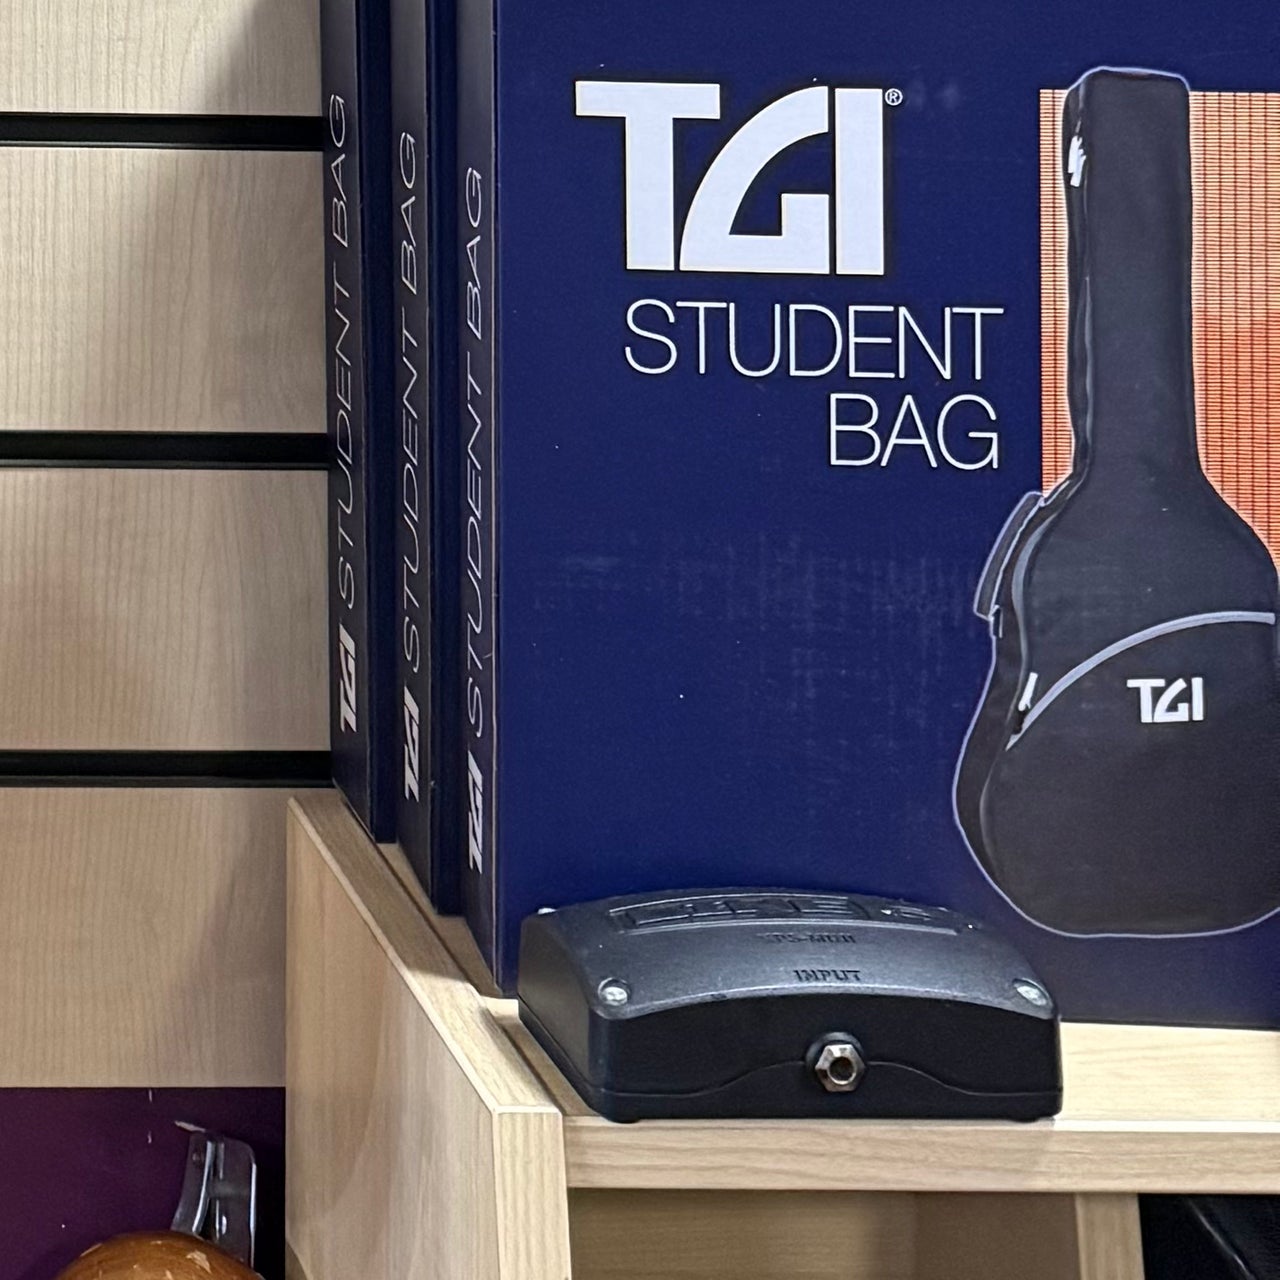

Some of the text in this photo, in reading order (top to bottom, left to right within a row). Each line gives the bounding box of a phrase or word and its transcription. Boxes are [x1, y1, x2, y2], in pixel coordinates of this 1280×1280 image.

[575, 80, 884, 276] TGI
[625, 298, 1005, 381] STUDENT
[329, 94, 357, 733] TGI STUDENT BAG
[399, 132, 421, 803] TGI STUDENT BAG
[829, 392, 999, 471] BAG
[465, 167, 484, 874] TGI STUDENT BAG
[1126, 677, 1204, 723] TGI
[793, 969, 861, 982] INPUT
